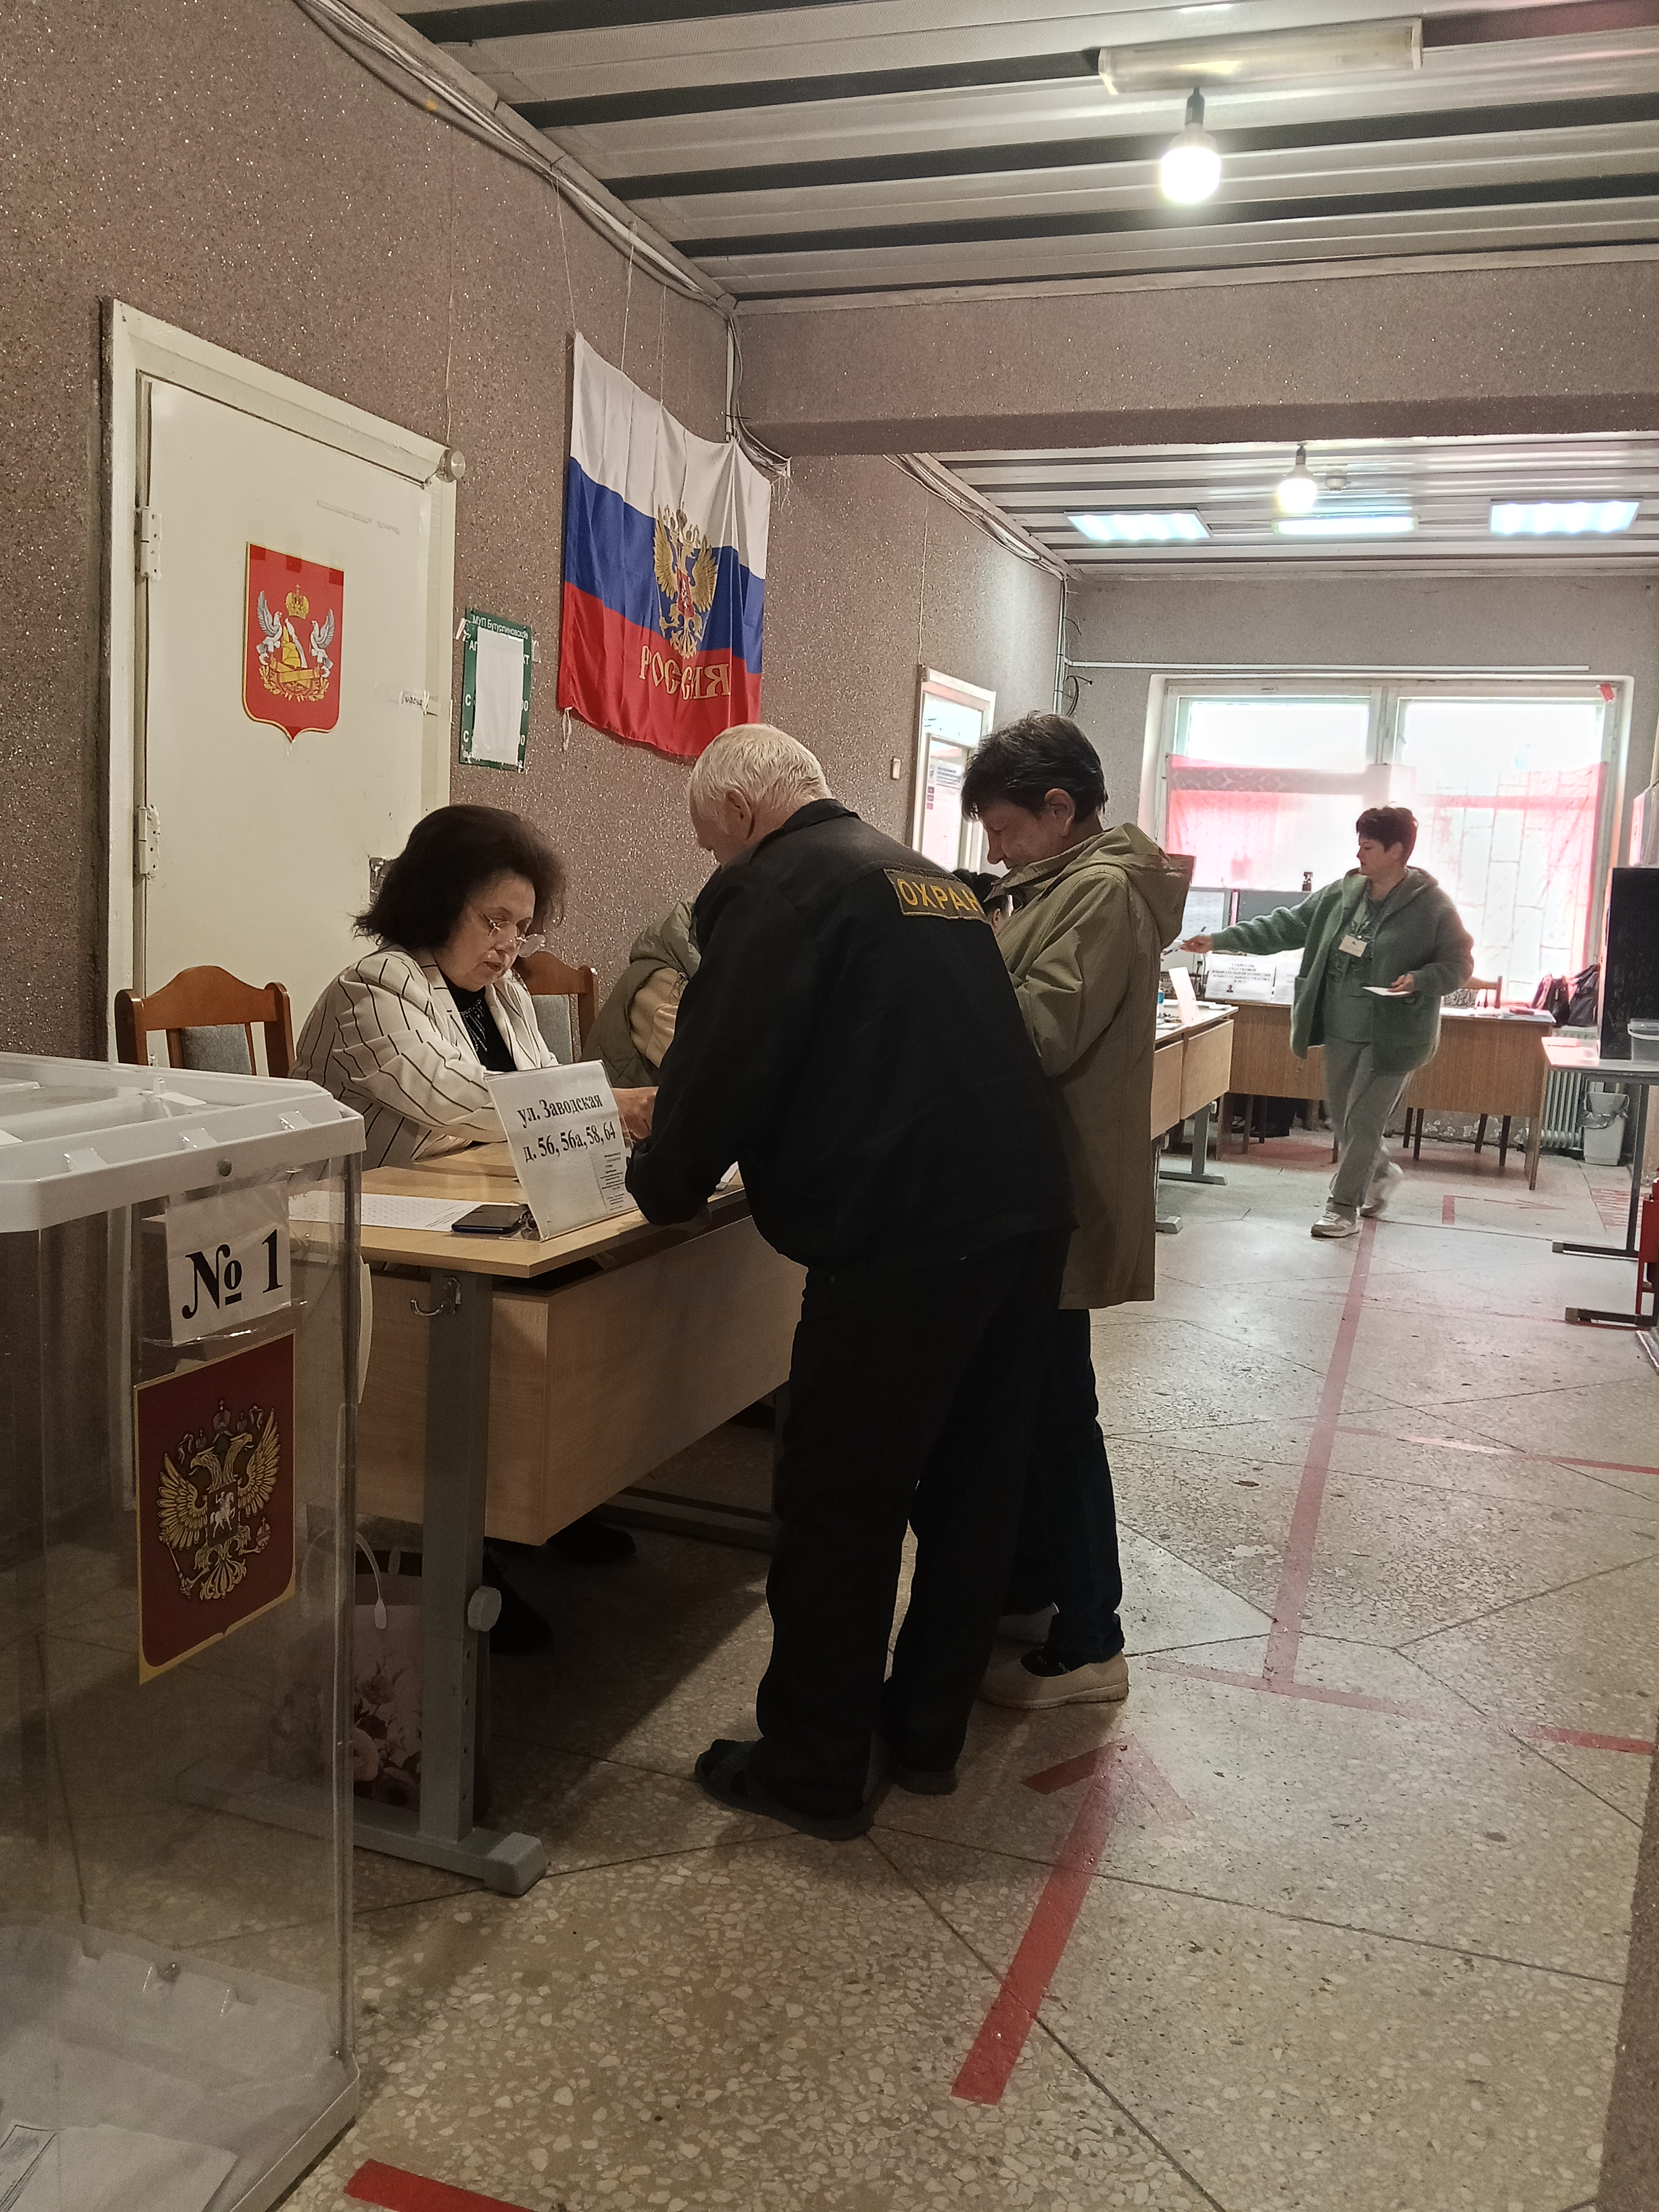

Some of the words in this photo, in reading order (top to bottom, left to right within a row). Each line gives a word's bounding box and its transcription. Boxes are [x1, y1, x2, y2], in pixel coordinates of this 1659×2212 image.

[472, 615, 487, 627] МУП
[639, 645, 731, 700] РОССИЯ
[897, 878, 981, 912] ОХРАН
[517, 1107, 541, 1129] ул.
[539, 1094, 603, 1118] Заводская
[523, 1145, 537, 1163] д.
[538, 1135, 561, 1157] 56,
[560, 1129, 588, 1151] 56а,
[585, 1124, 604, 1145] 58,
[603, 1121, 616, 1141] 64
[182, 1244, 242, 1319] №
[261, 1229, 283, 1293] 1
